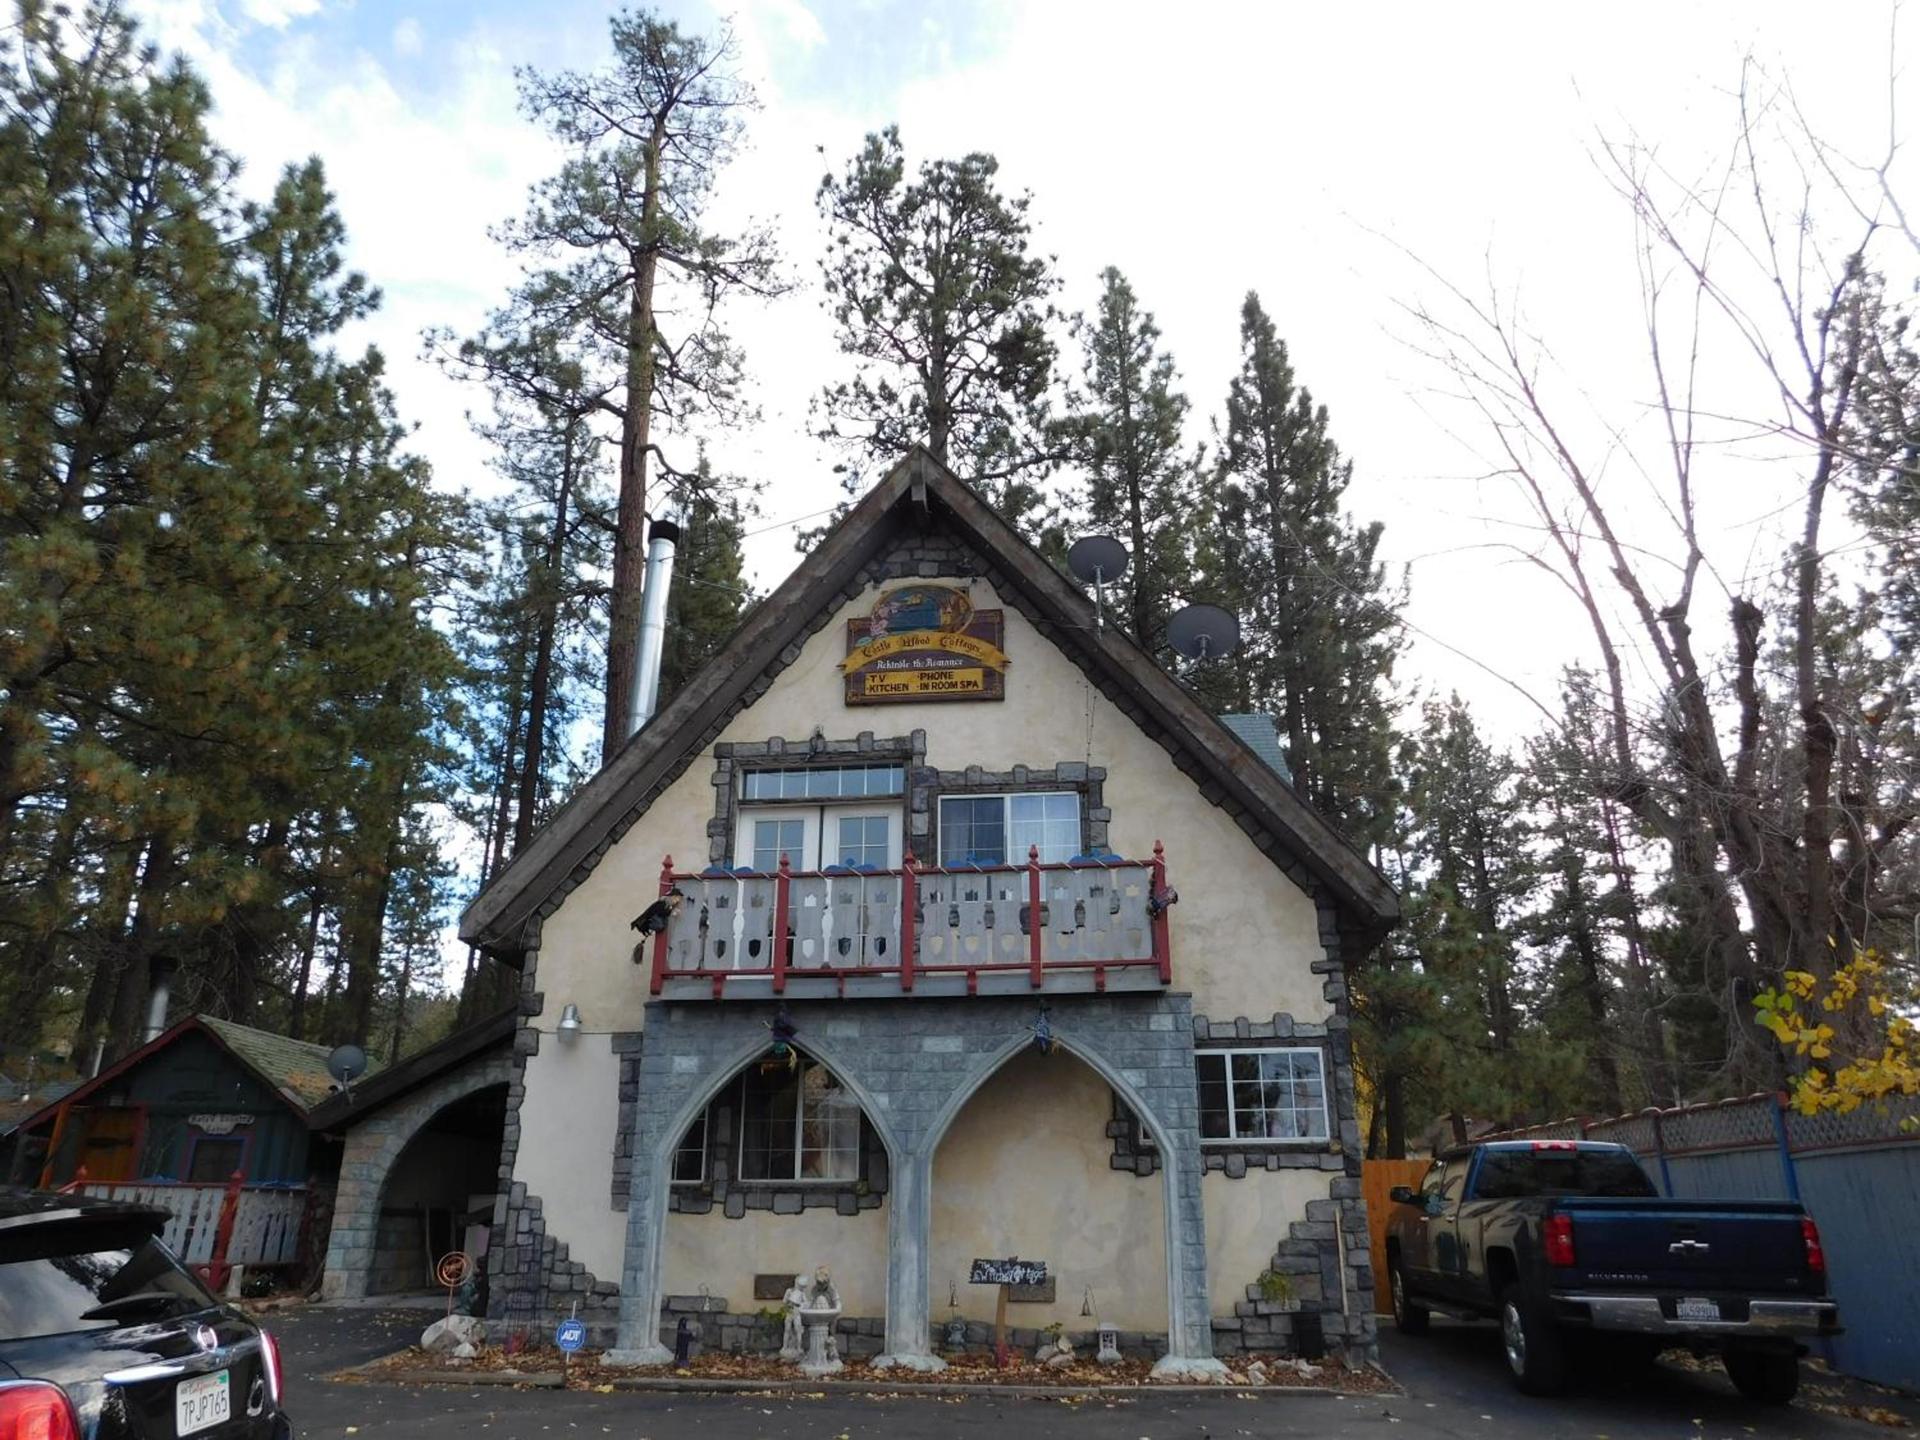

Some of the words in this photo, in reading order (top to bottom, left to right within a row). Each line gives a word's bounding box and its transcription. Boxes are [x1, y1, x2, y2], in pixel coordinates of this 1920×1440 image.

[920, 672, 953, 681] PHONE
[869, 683, 909, 692] KITCHEN
[920, 683, 929, 691] IN
[932, 682, 958, 690] ROOM
[960, 681, 979, 689] SPA
[561, 1330, 581, 1341] ADT
[182, 1390, 227, 1427] 7PJP765
